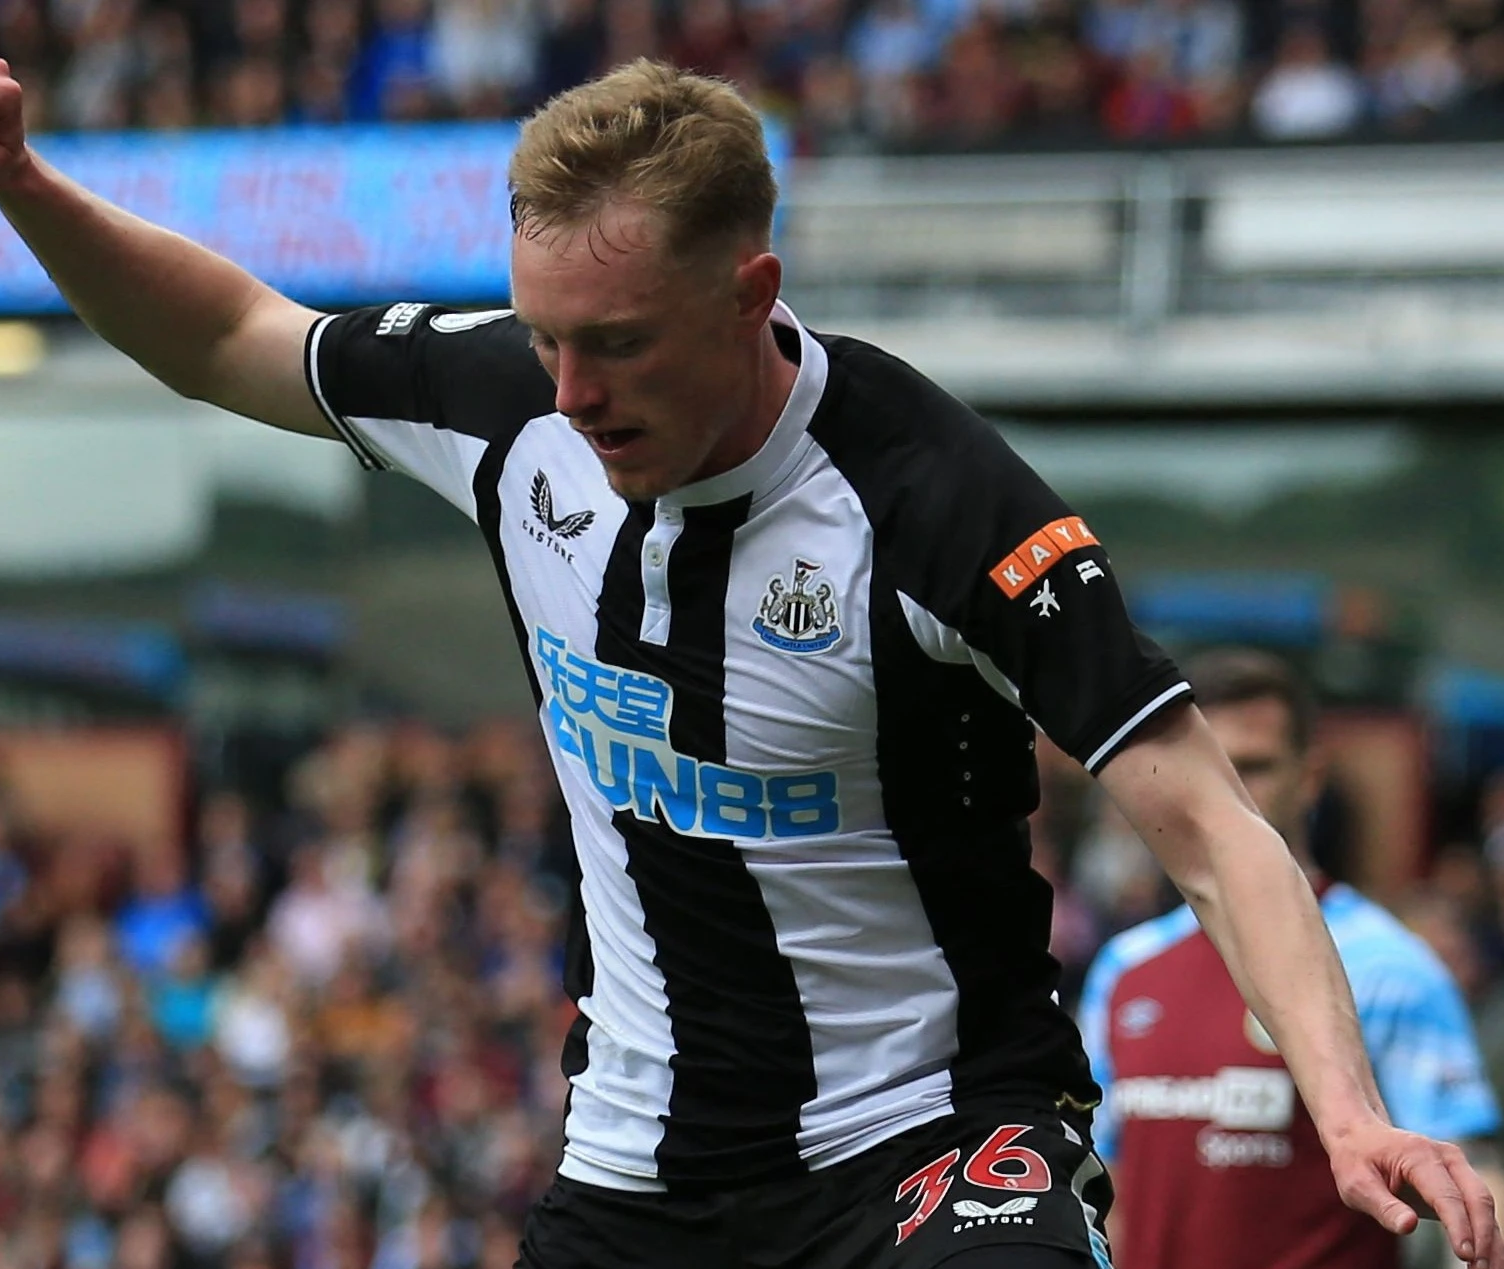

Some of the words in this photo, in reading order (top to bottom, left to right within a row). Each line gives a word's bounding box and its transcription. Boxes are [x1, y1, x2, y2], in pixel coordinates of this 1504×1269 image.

[521, 519, 575, 565] CASTORE
[1001, 521, 1099, 588] KAYA
[548, 695, 839, 837] FUN88
[894, 1124, 1052, 1247] 36
[953, 1216, 1035, 1234] CASTORE
